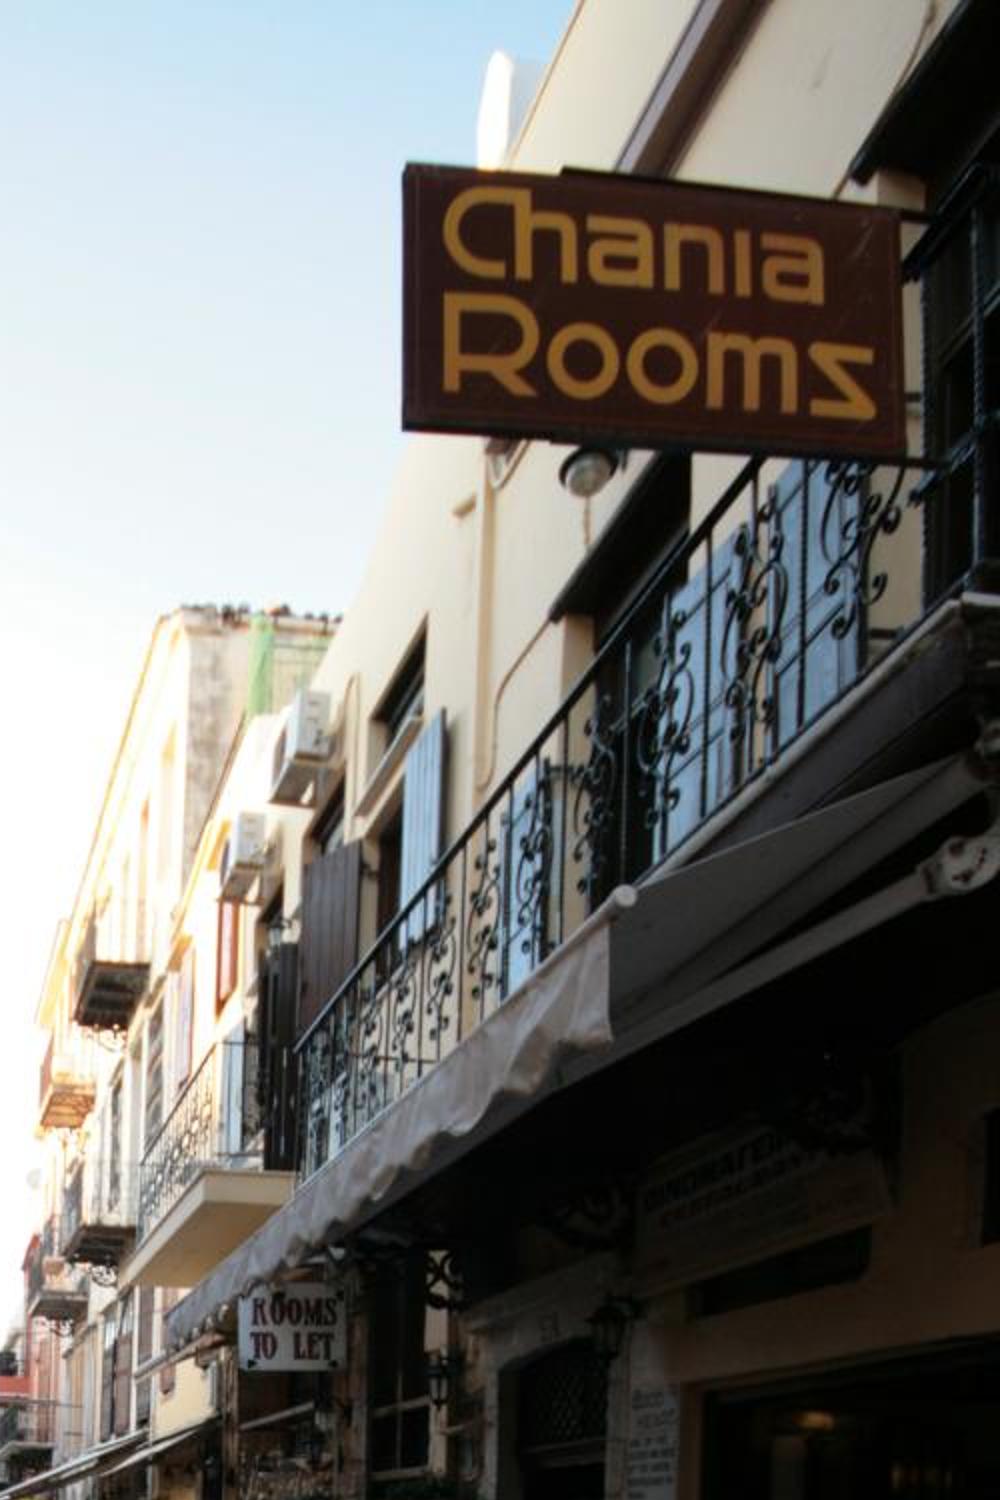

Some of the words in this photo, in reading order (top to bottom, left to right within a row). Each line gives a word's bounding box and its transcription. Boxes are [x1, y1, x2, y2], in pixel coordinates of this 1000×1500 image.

[442, 185, 825, 305] Chania
[442, 290, 878, 421] Rooms
[251, 1332, 277, 1360] TO
[294, 1332, 334, 1360] LET
[252, 1298, 337, 1326] ROOMS
